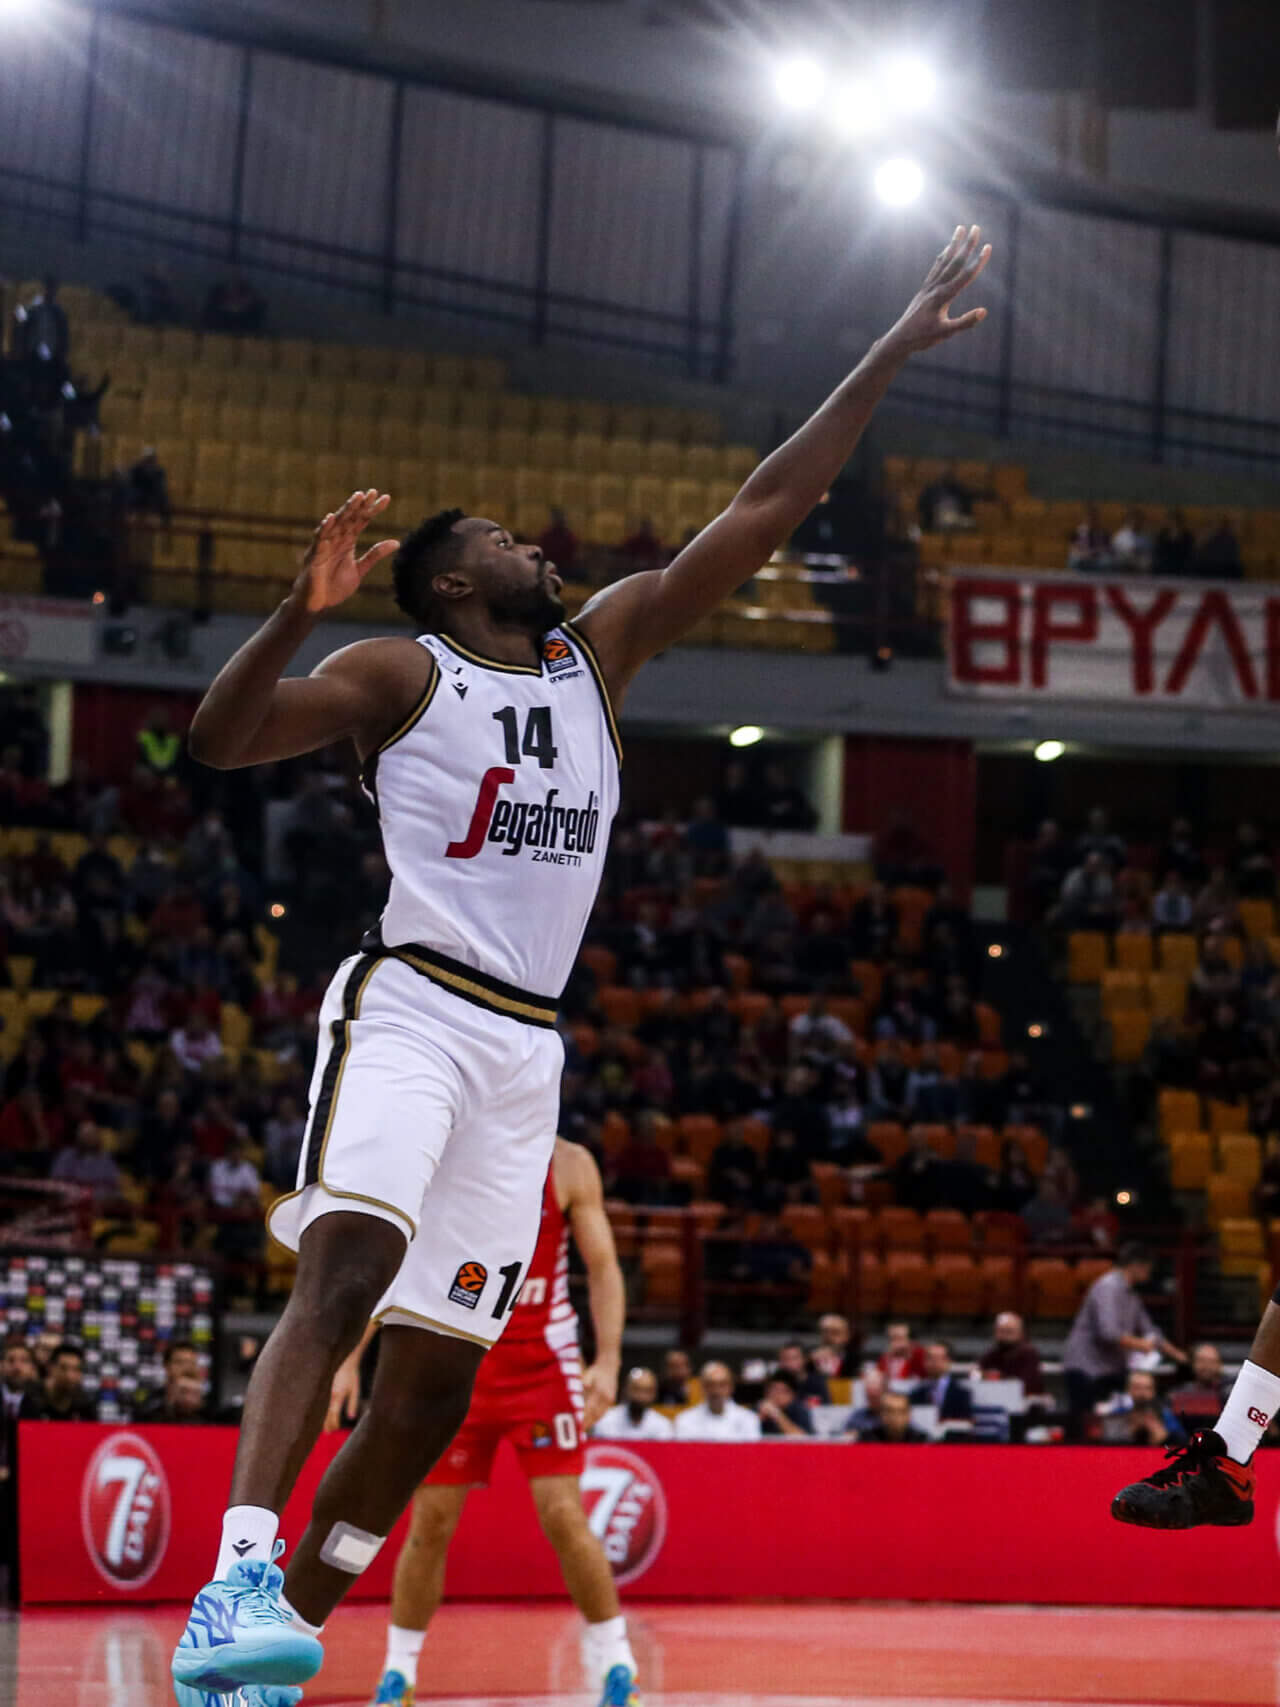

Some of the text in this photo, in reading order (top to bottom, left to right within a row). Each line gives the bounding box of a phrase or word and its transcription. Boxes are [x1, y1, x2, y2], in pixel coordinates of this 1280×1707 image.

[492, 706, 558, 769] 14
[445, 766, 599, 858] Segafredo
[532, 849, 581, 868] ZANETTI
[98, 1456, 147, 1566] 7
